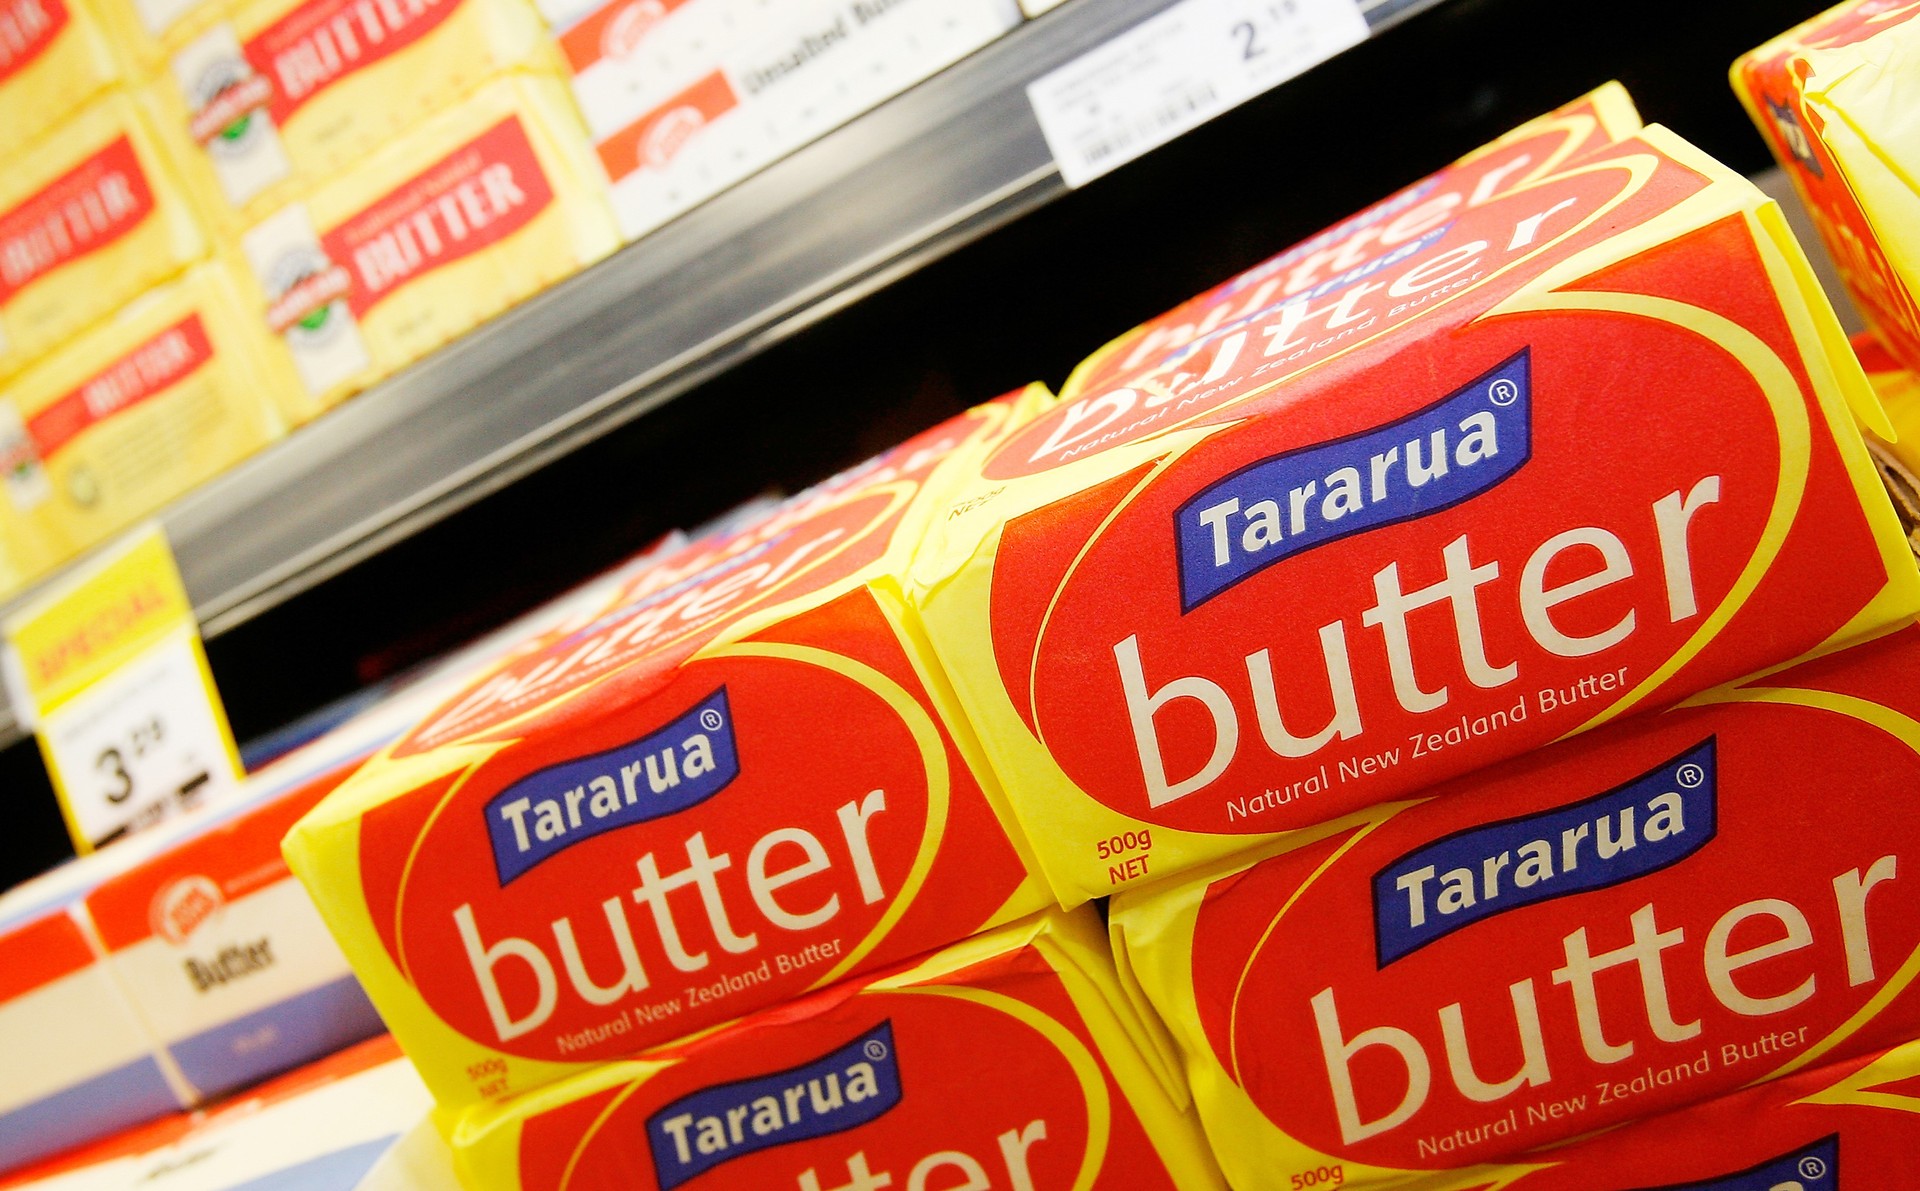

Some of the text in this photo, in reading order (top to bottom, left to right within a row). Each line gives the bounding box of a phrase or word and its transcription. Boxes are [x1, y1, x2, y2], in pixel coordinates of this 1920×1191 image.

[275, 0, 442, 98] BUTT
[1231, 22, 1266, 60] 2
[353, 162, 526, 292] BUTTER
[1028, 197, 1577, 464] butter
[1059, 270, 1483, 461] Natural New Zealand Butter
[1199, 409, 1501, 567] Tararua
[1113, 475, 1720, 809] butter
[96, 747, 133, 804] 3
[501, 733, 716, 852] Tararua
[1226, 666, 1628, 822] Natural New Zealand Butter
[1096, 829, 1153, 860] 500g
[1108, 854, 1149, 885] NET
[1397, 793, 1685, 929] Tararua
[453, 790, 886, 1043] butter
[556, 939, 841, 1055] Natural New Zealand Butter
[1310, 855, 1898, 1146] butter
[663, 1062, 879, 1164] Tararua
[1417, 1026, 1809, 1159] Natural New Zealand Butter
[1291, 1165, 1343, 1191] 500g
